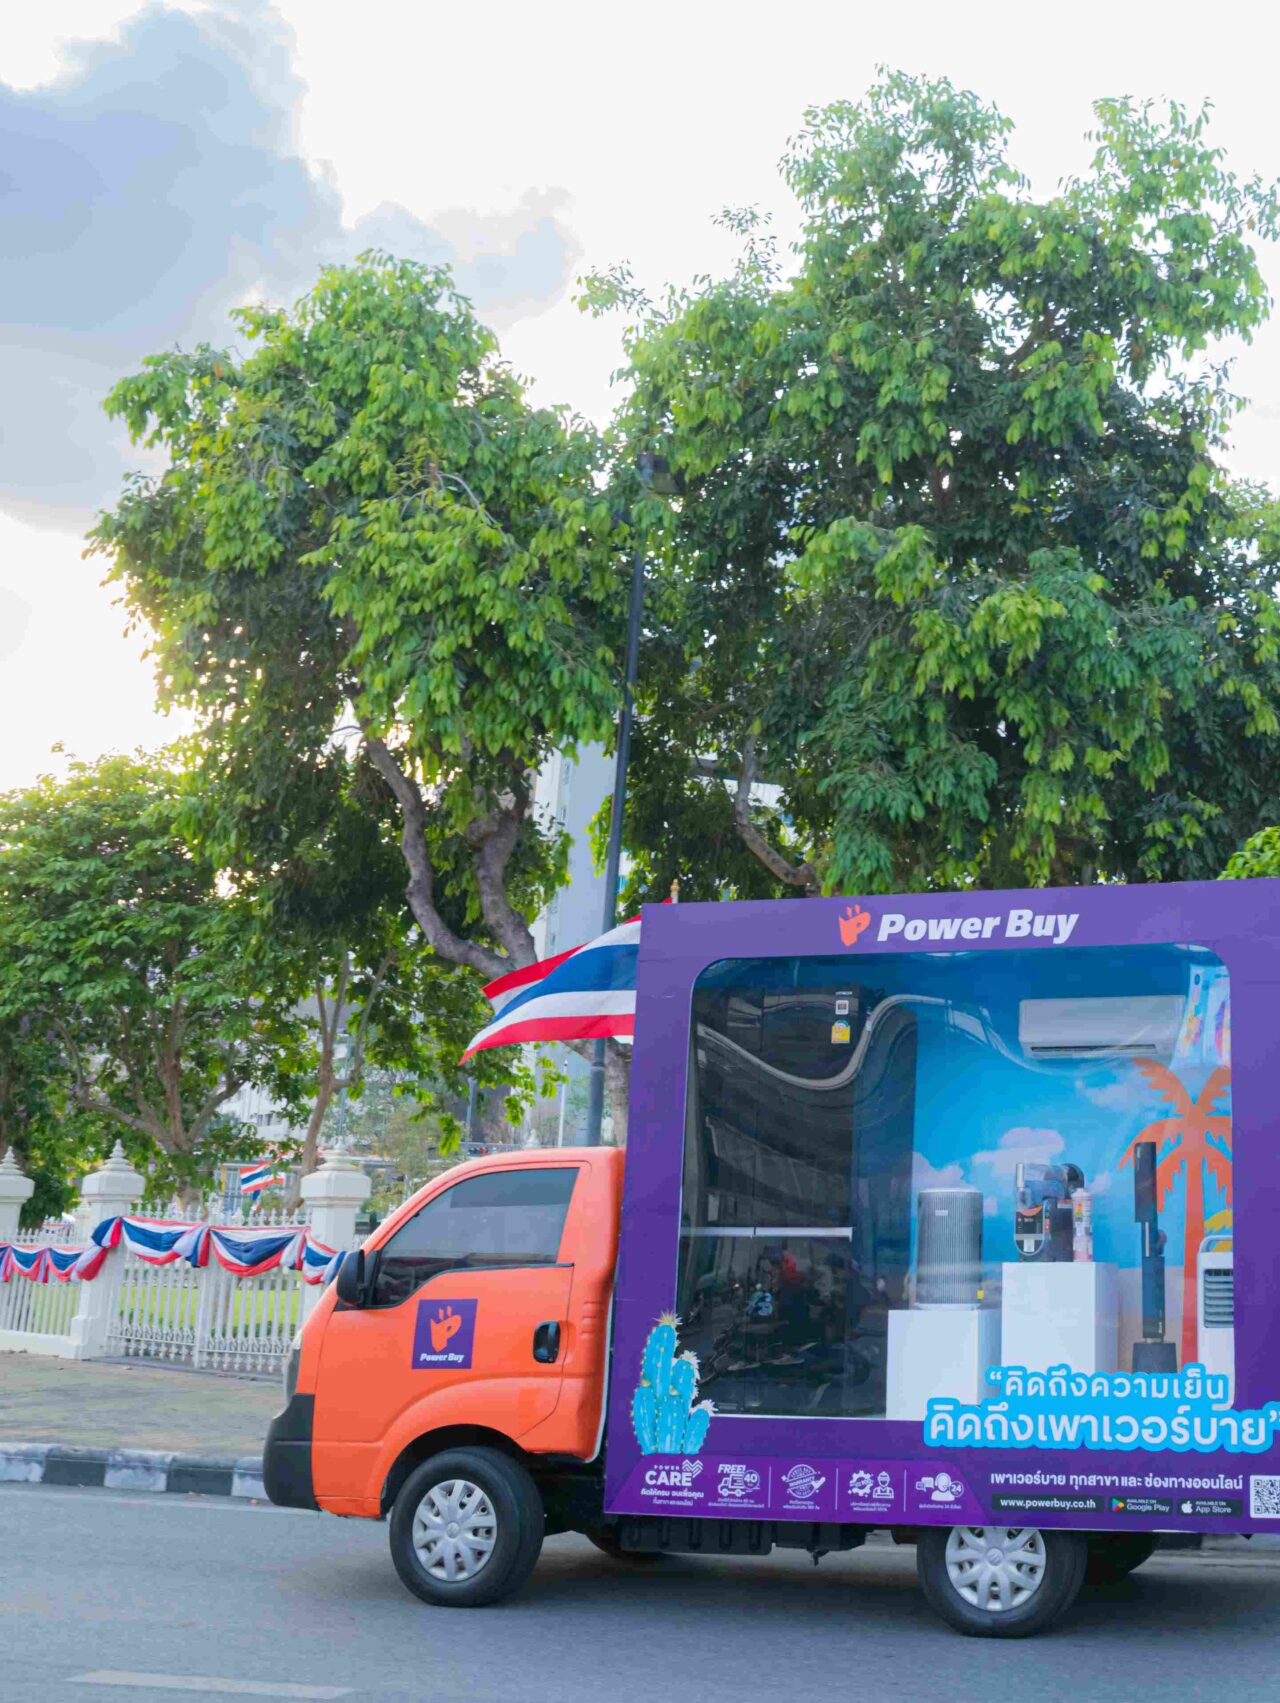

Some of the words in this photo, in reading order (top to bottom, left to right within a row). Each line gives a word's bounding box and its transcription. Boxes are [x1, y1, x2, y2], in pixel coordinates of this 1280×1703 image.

[877, 913, 1001, 942] Power
[1005, 909, 1079, 944] Buy
[420, 1353, 447, 1361] Power
[448, 1353, 464, 1363] Buy
[717, 1464, 746, 1474] FREE!
[645, 1471, 692, 1486] CARE
[743, 1473, 758, 1483] 40
[991, 1470, 1066, 1485] เพาเวอร์บาย
[1144, 1472, 1243, 1489] ช่องทางออนไลน์
[951, 1484, 962, 1492] 24
[1000, 1497, 1096, 1510] www.powerbuy.co.th
[1127, 1503, 1152, 1512] Google
[1154, 1503, 1169, 1512] Play
[1196, 1505, 1210, 1513] App
[1212, 1505, 1232, 1513] Store
